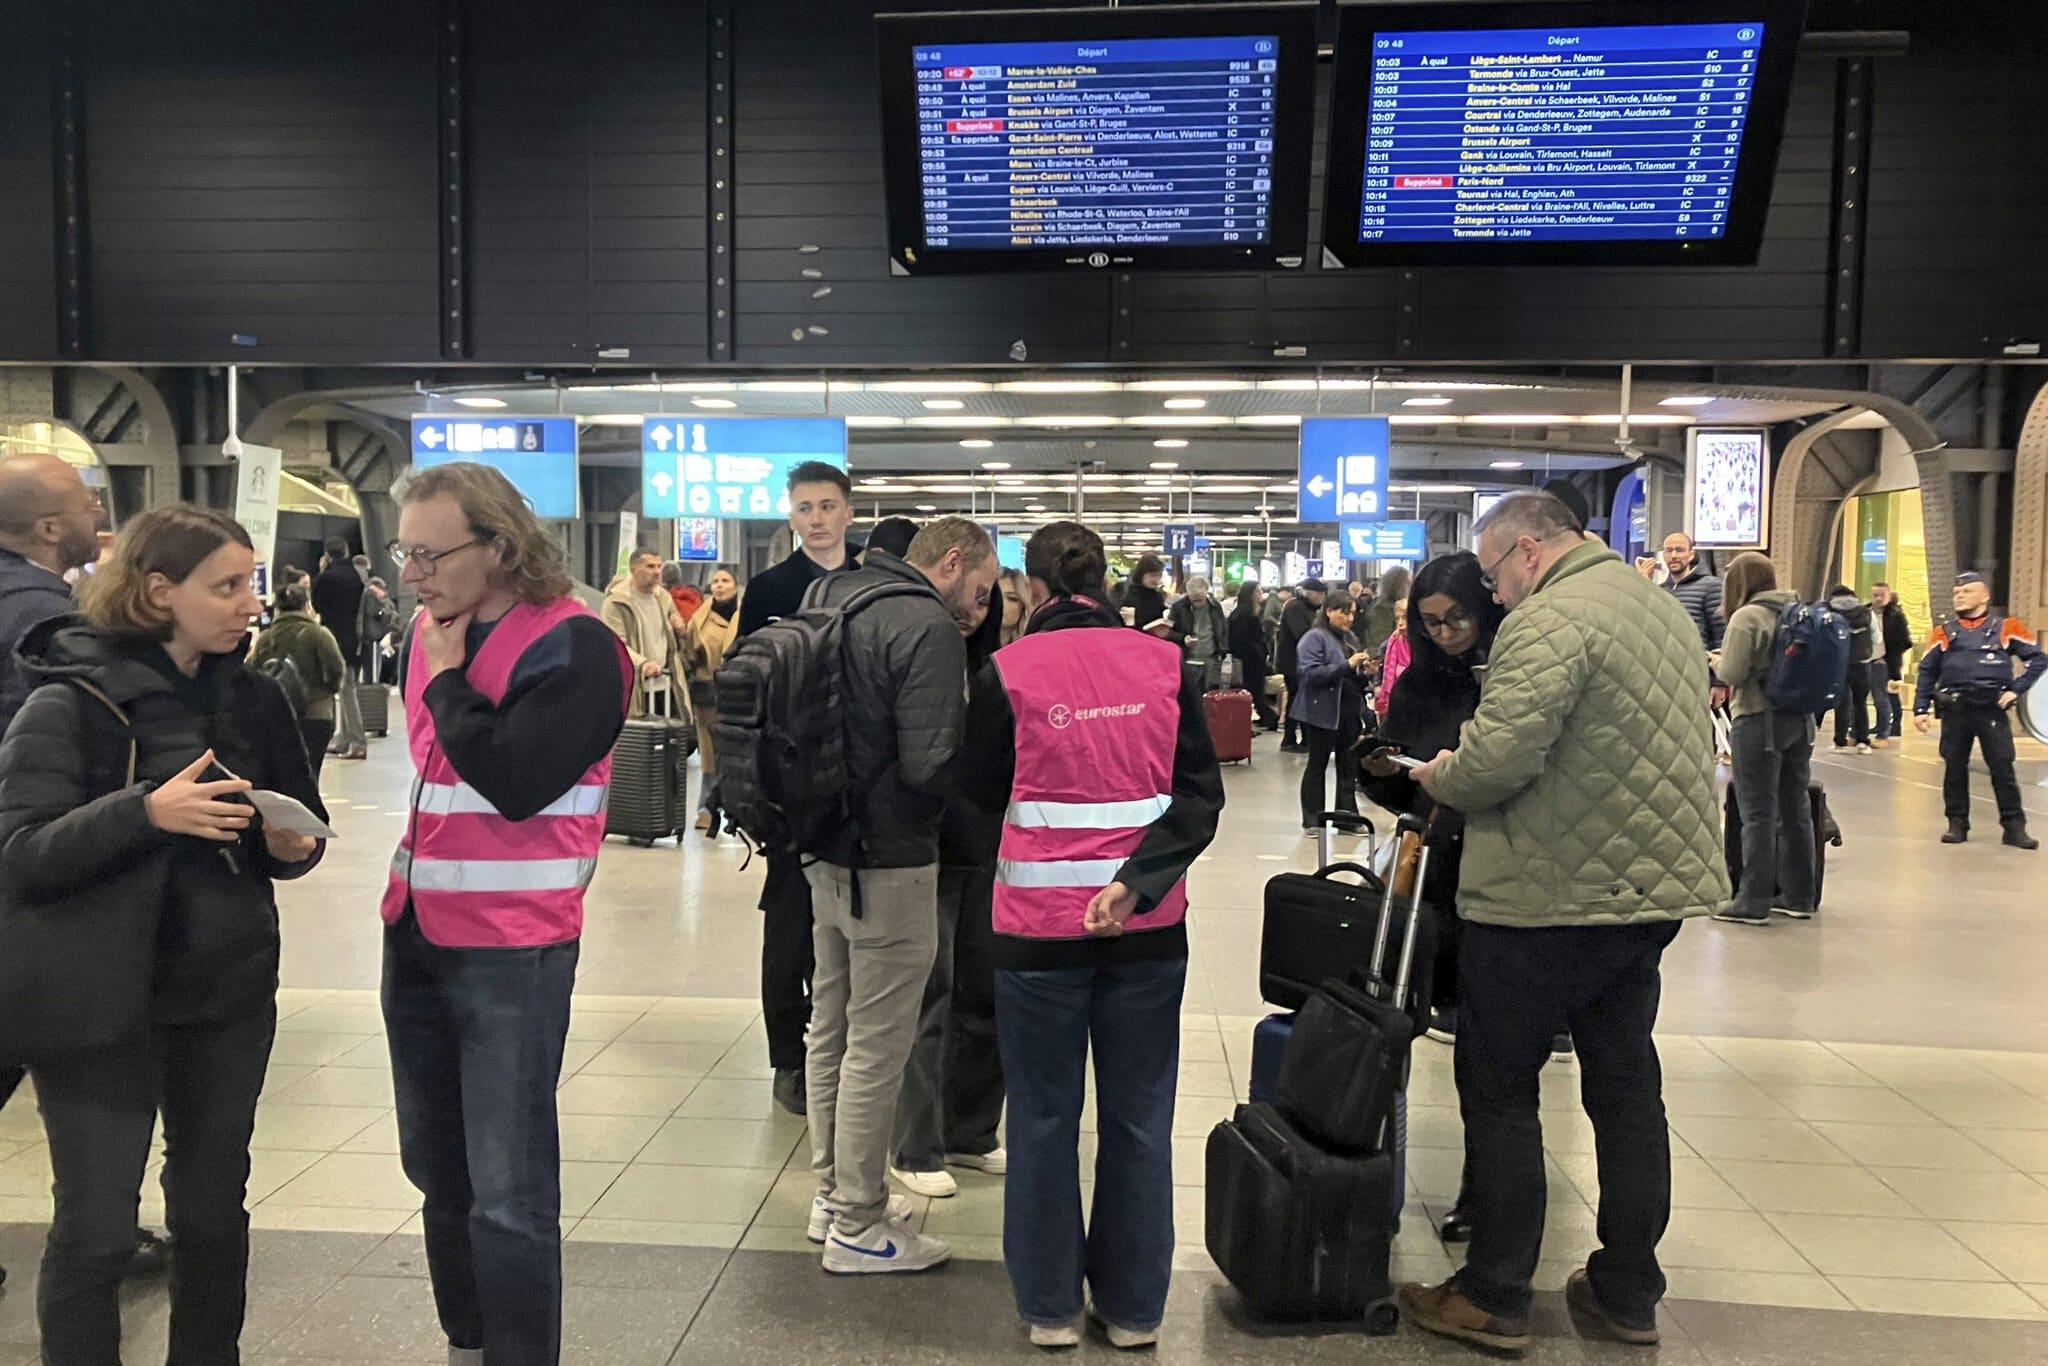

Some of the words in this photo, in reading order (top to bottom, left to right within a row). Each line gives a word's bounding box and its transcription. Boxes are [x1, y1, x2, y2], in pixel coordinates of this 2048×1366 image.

[1548, 35, 1580, 45] Départ
[1079, 47, 1107, 57] Départ
[1377, 57, 1400, 66] 10:03
[1421, 54, 1429, 65] À
[1429, 56, 1448, 66] quai
[1573, 53, 1603, 62] Namur
[1707, 50, 1719, 58] IC
[1469, 69, 1514, 78] Termonde
[1515, 69, 1528, 77] via
[1530, 68, 1581, 78] Brux-Ouest,
[1582, 67, 1605, 76] Jette
[969, 82, 985, 91] quai
[1008, 80, 1055, 89] Amsterdam
[1057, 79, 1076, 88] Zuid
[1468, 82, 1540, 92] Braine-le-Comte
[1541, 82, 1554, 90] via
[1556, 82, 1571, 90] Hal
[969, 95, 986, 104] quai
[1008, 94, 1031, 103] Essen
[1034, 94, 1045, 102] via
[1046, 93, 1080, 102] Malines,
[1083, 92, 1112, 102] Anvers,
[1229, 89, 1238, 97] IC
[1374, 99, 1397, 107] 10:04
[1466, 96, 1533, 106] Anvers-Central
[1534, 96, 1547, 104] via
[1548, 95, 1601, 105] Schaerbeek,
[1603, 94, 1641, 104] Vilvorde,
[1643, 93, 1677, 102] Malines
[970, 108, 986, 118] quai
[1008, 107, 1041, 116] Brussels
[1044, 106, 1072, 116] Airport
[1075, 106, 1087, 114] via
[1089, 105, 1122, 115] Diegem,
[1124, 104, 1164, 113] Zaventem
[1372, 112, 1395, 121] 10:07
[1465, 110, 1502, 119] Courtrai
[1503, 110, 1516, 118] via
[1517, 109, 1576, 119] Denderleeuw,
[1577, 108, 1622, 118] Zottegem,
[1624, 107, 1671, 116] Audenarde
[1697, 106, 1709, 114] IC
[1009, 120, 1039, 129] Knokke
[1041, 120, 1053, 128] via
[1100, 118, 1127, 128] Bruges
[1228, 116, 1238, 124] IC
[1371, 126, 1394, 134] 10:07
[1463, 124, 1500, 133] Ostende
[1502, 124, 1515, 132] via
[1516, 123, 1561, 133] Gand-St-P,
[1563, 122, 1593, 132] Bruges
[1695, 120, 1706, 128] IC
[952, 135, 961, 143] En
[963, 135, 999, 144] approche
[1084, 132, 1095, 140] via
[1098, 131, 1152, 141] Denderleeuw,
[1155, 131, 1178, 140] Alost,
[1180, 130, 1217, 138] Wetteren
[1228, 129, 1237, 137] IC
[1370, 139, 1393, 147] 10:09
[1462, 137, 1497, 146] Brussels
[1498, 137, 1530, 146] Airport
[1009, 146, 1056, 155] Amsterdam
[1058, 145, 1093, 154] Centraal
[1369, 152, 1388, 160] 10:11
[1461, 151, 1484, 159] Genk
[1485, 151, 1498, 159] via
[1499, 150, 1535, 160] Louvain,
[1536, 149, 1580, 159] Tirlemont,
[1581, 149, 1612, 157] Hasselt
[1690, 147, 1701, 155] IC
[1010, 160, 1032, 168] Mons
[1099, 158, 1128, 166] Jurbise
[1227, 155, 1236, 163] IC
[1533, 163, 1545, 171] via
[1547, 163, 1561, 171] Bru
[1562, 162, 1596, 172] Airport,
[1597, 162, 1633, 171] Louvain,
[1634, 161, 1676, 169] Tirlemont
[972, 174, 989, 182] quai
[1010, 172, 1071, 181] Anvers-Central
[1086, 171, 1120, 180] Vilvorde,
[1123, 170, 1153, 178] Malines
[1226, 168, 1235, 176] IC
[1458, 177, 1504, 185] Paris-Nord
[1010, 185, 1035, 194] Eupen
[1037, 185, 1048, 193] via
[1051, 185, 1083, 193] Louvain,
[1226, 181, 1235, 189] IC
[1456, 190, 1489, 198] Tournai
[1490, 190, 1502, 198] via
[1504, 190, 1521, 198] Hal,
[1522, 189, 1559, 198] Enghien,
[1560, 189, 1575, 197] Ath
[1683, 187, 1694, 195] IC
[1011, 198, 1057, 206] Schaerbeek
[1225, 194, 1235, 202] IC
[1455, 203, 1529, 211] Charleroi-Central
[1530, 202, 1543, 210] via
[1593, 201, 1628, 210] Nivelles,
[1630, 201, 1656, 209] Luttre
[1680, 200, 1692, 208] IC
[1011, 211, 1042, 219] Nivelles
[1107, 209, 1145, 218] Waterloo,
[1454, 216, 1495, 225] Zottegem
[1510, 215, 1558, 224] Liedekerke,
[1559, 214, 1614, 223] Denderleeuw
[1012, 223, 1042, 231] Louvain
[1058, 222, 1105, 231] Schaerbeek,
[1107, 221, 1139, 230] Diegem,
[1142, 221, 1180, 229] Zaventem
[1453, 228, 1495, 236] Termonde
[1496, 228, 1508, 236] via
[1510, 228, 1531, 236] Jette
[1676, 226, 1687, 234] IC
[1012, 236, 1032, 244] Alost
[1117, 234, 1168, 242] Denderleeuw
[1075, 703, 1146, 720] eurostar
